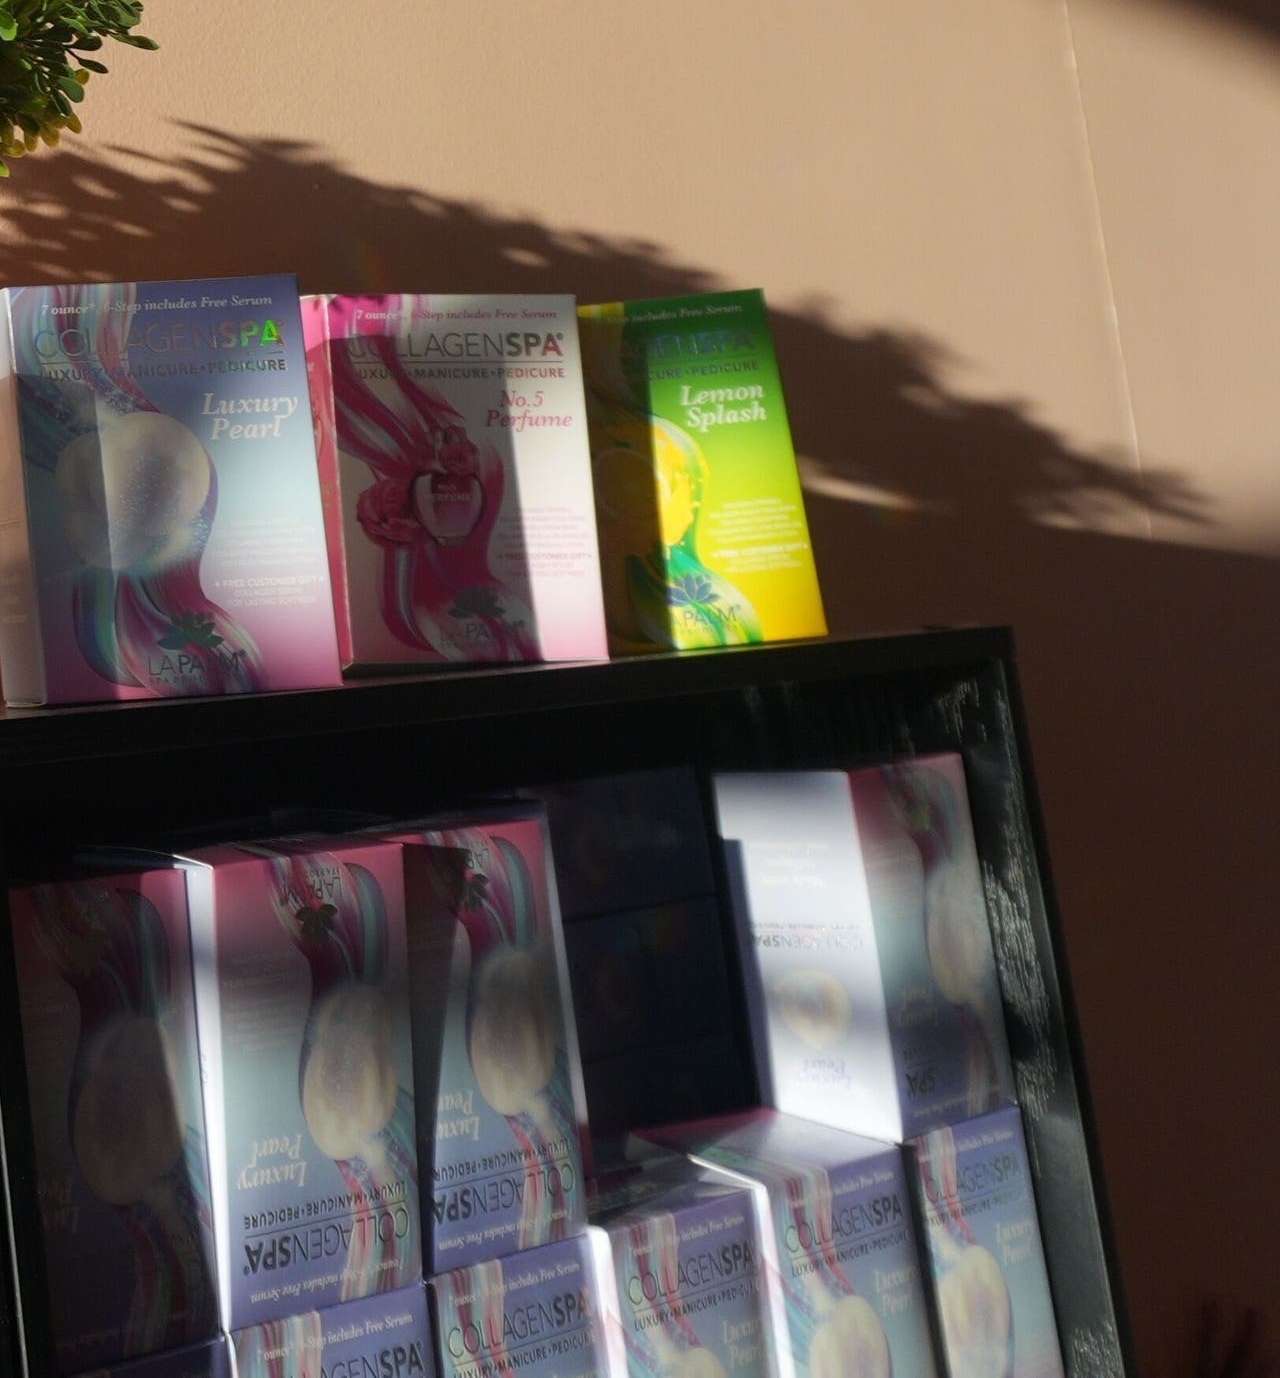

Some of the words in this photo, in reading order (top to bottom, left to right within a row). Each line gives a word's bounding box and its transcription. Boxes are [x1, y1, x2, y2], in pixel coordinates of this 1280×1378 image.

[144, 297, 197, 311] includes
[200, 297, 228, 308] Free
[232, 296, 272, 307] Serum
[446, 310, 490, 319] includes
[495, 309, 517, 319] Free
[521, 309, 558, 319] Serum
[202, 392, 299, 418] Luxury
[500, 390, 544, 407] No.5
[680, 384, 765, 406] Lemon
[211, 417, 283, 440] Pearl
[486, 409, 573, 433] Perfume
[687, 401, 767, 433] Splash
[247, 1134, 303, 1168] Pearl
[236, 1161, 307, 1191] Luxury
